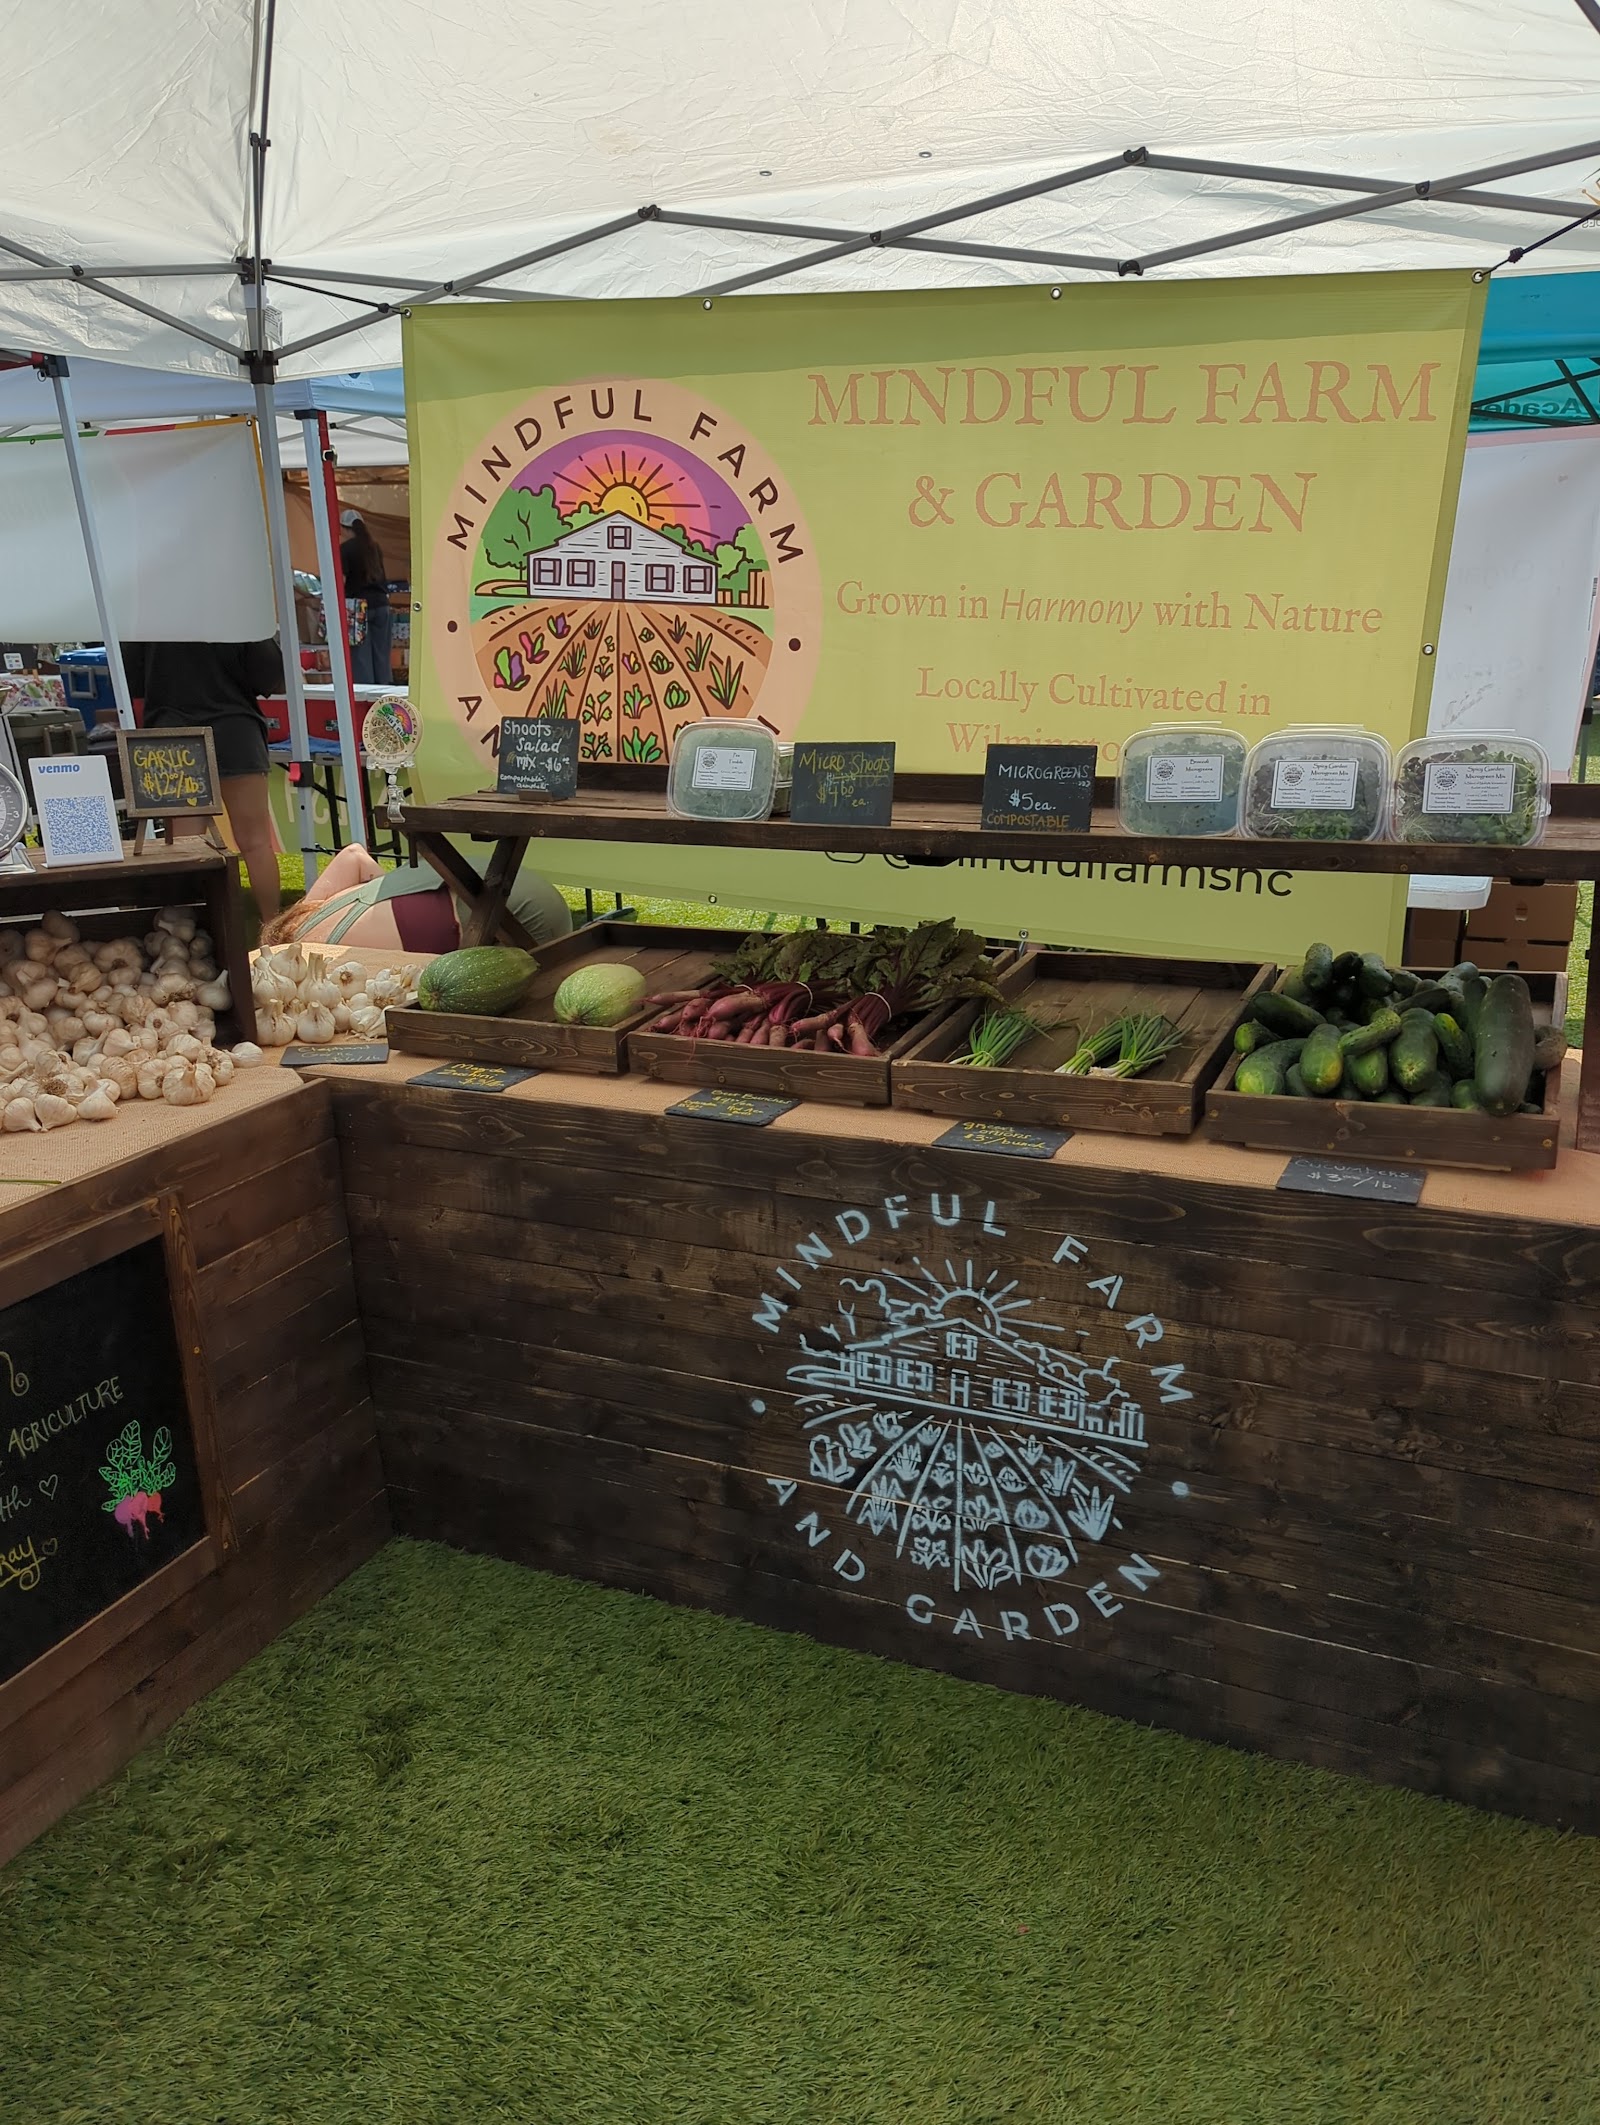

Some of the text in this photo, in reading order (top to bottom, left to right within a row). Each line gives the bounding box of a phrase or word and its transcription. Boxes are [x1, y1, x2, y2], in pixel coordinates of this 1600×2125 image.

[807, 360, 1441, 425] MINDFUL FARM
[447, 387, 804, 565] MINDFUL FARM
[907, 472, 1317, 533] & GARDEN
[836, 580, 1383, 634] Grown in Harmony with Nature
[915, 667, 1272, 717] Locally Cultivated in
[504, 719, 551, 738] Shoots
[515, 737, 562, 754] Salad
[38, 764, 80, 774] venmo
[133, 749, 196, 769] GARLIC
[851, 752, 890, 774] Shoots
[999, 764, 1090, 779] MICROGREENS
[987, 813, 1070, 828] COMPOSTABLE
[751, 1193, 1194, 1404] MINDFUL FARM
[8, 1376, 124, 1460] AGRICULTURE
[766, 1477, 1161, 1641] AND GARDEN
